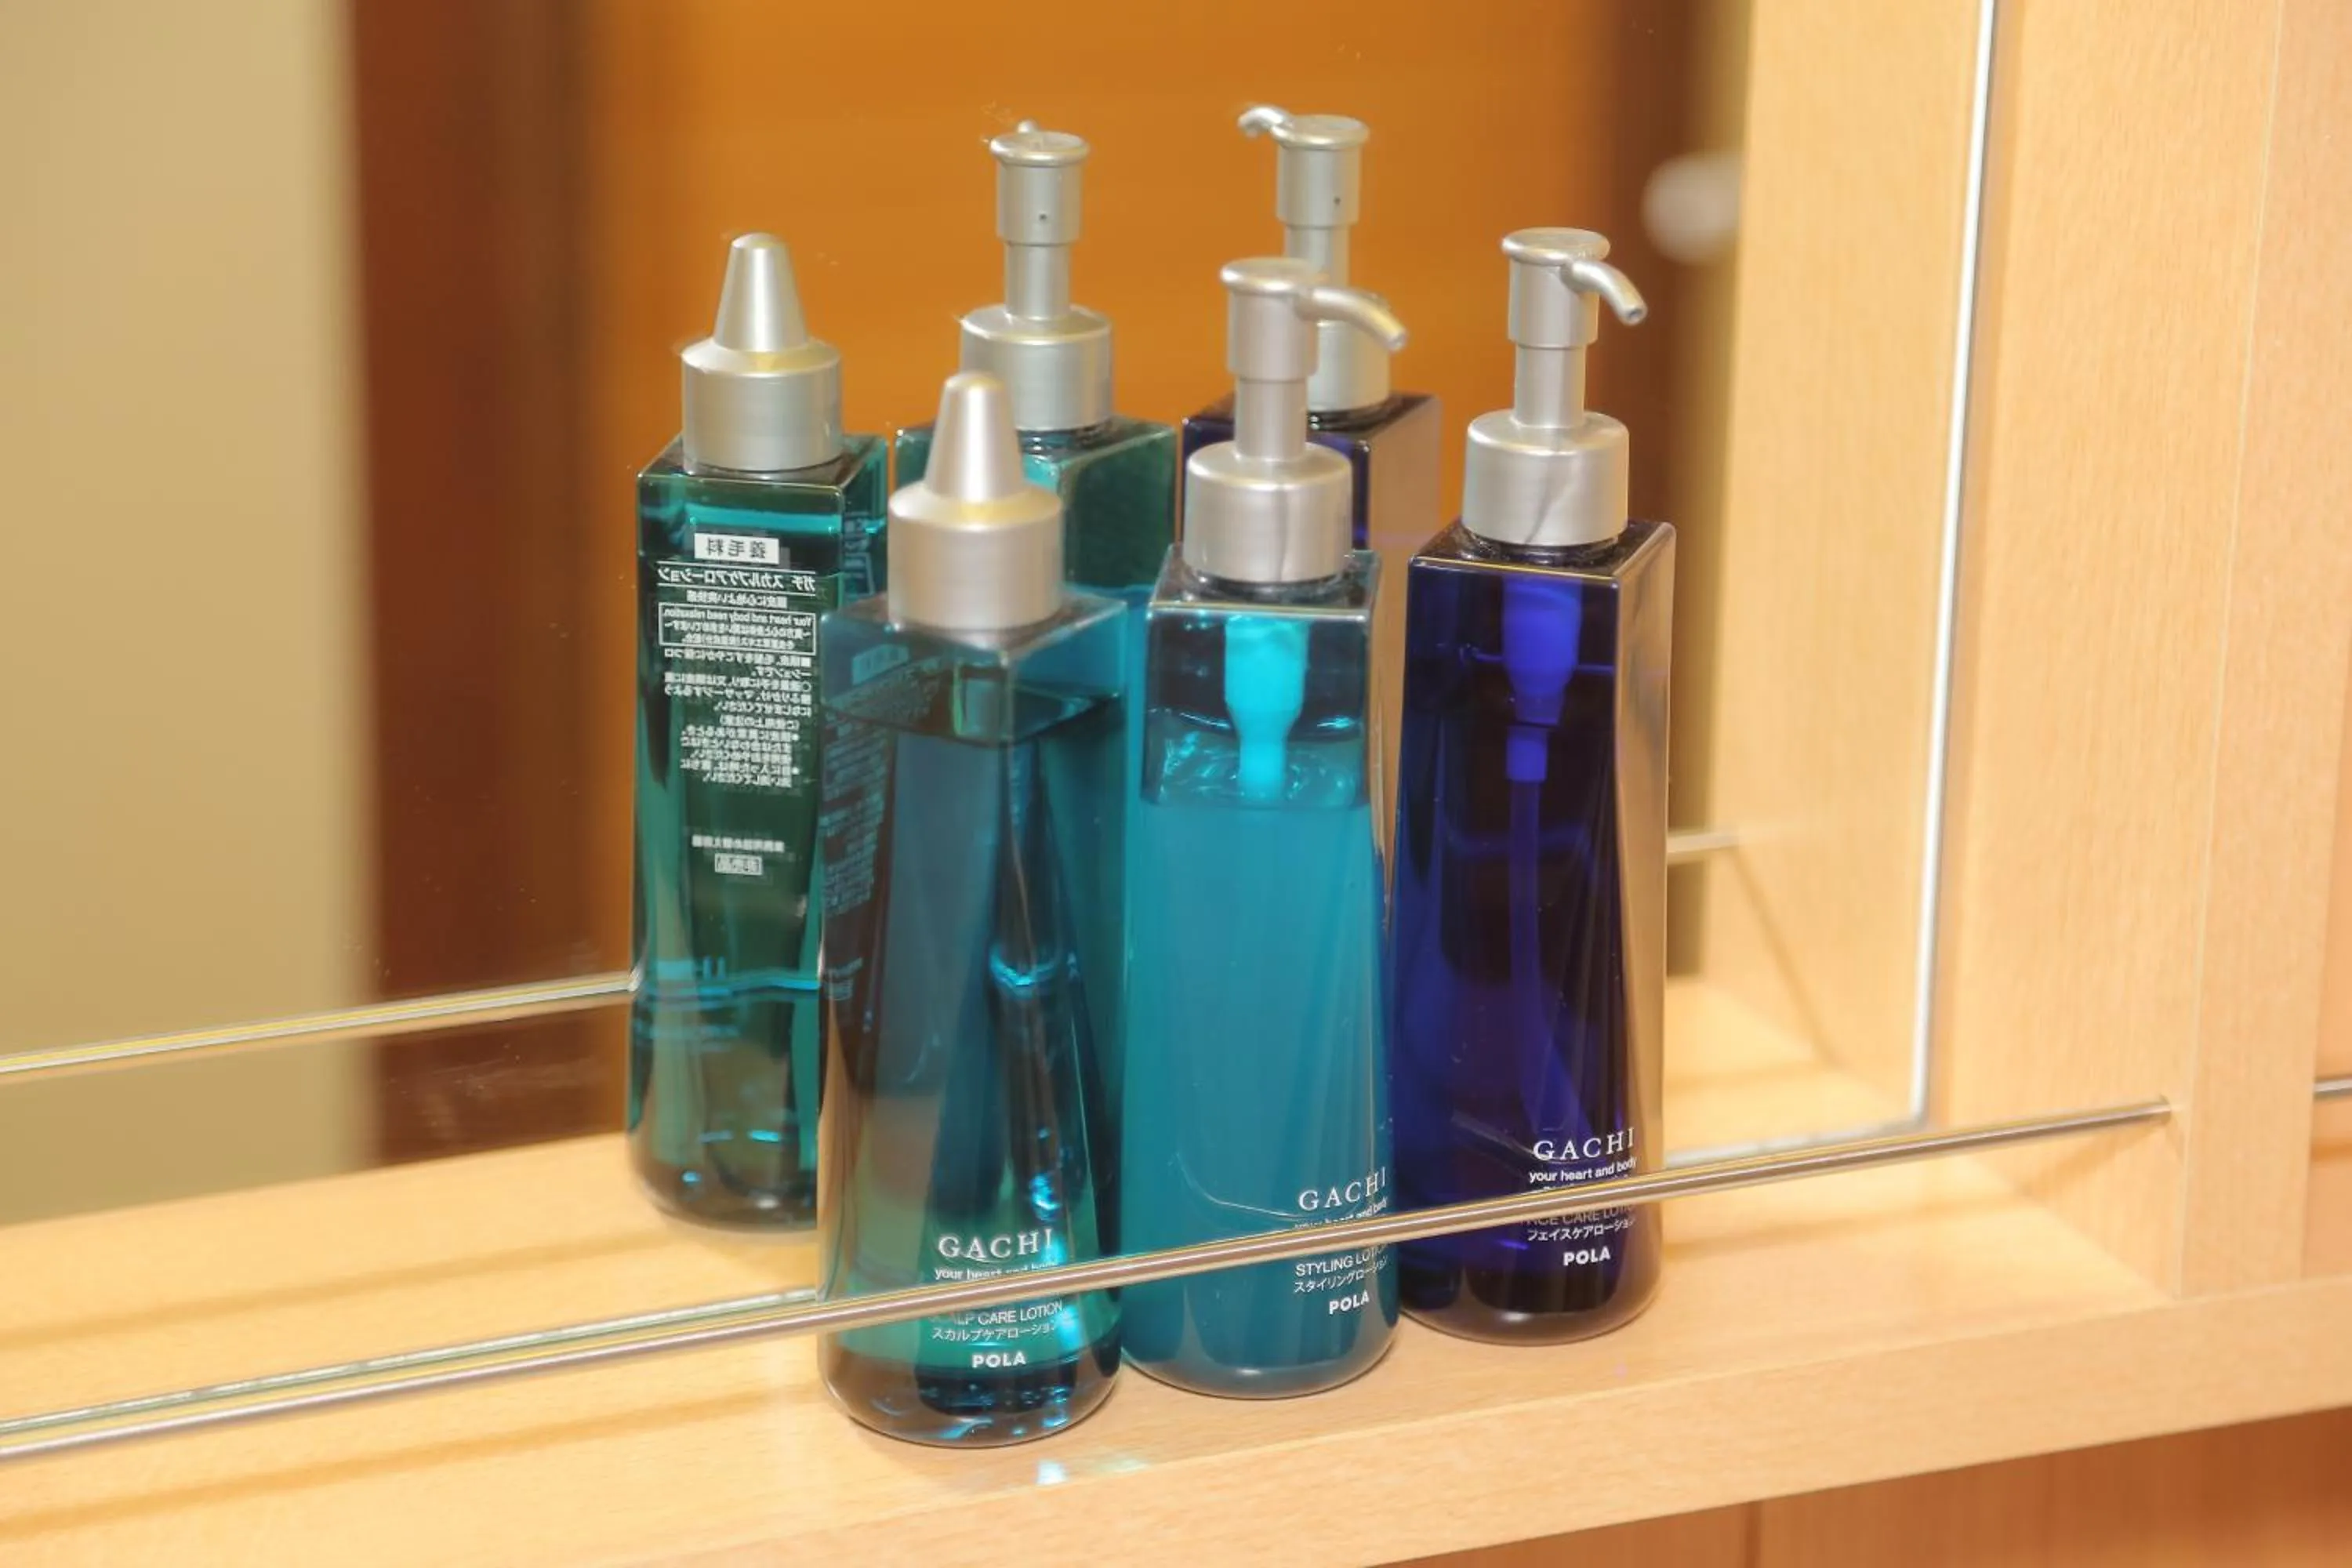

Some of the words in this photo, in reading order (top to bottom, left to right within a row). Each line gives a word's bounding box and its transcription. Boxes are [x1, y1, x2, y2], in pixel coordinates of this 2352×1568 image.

[1533, 1127, 1635, 1161] GACHI
[1530, 1171, 1558, 1184] your
[1561, 1168, 1592, 1181] heart
[1595, 1163, 1615, 1178] and
[1617, 1156, 1637, 1173] body
[1298, 1166, 1386, 1211] GACHI
[1527, 1215, 1635, 1241] フェイスケアローション
[938, 1228, 1053, 1259] GACHI
[1563, 1246, 1611, 1266] POLA
[935, 1267, 964, 1280] your
[1294, 1254, 1388, 1293] スタイリングローション
[1295, 1254, 1355, 1277] STYLING
[978, 1309, 1017, 1325] CARE
[1020, 1300, 1063, 1321] LOTION
[1329, 1290, 1370, 1315] POLA
[971, 1351, 1026, 1369] POLA
